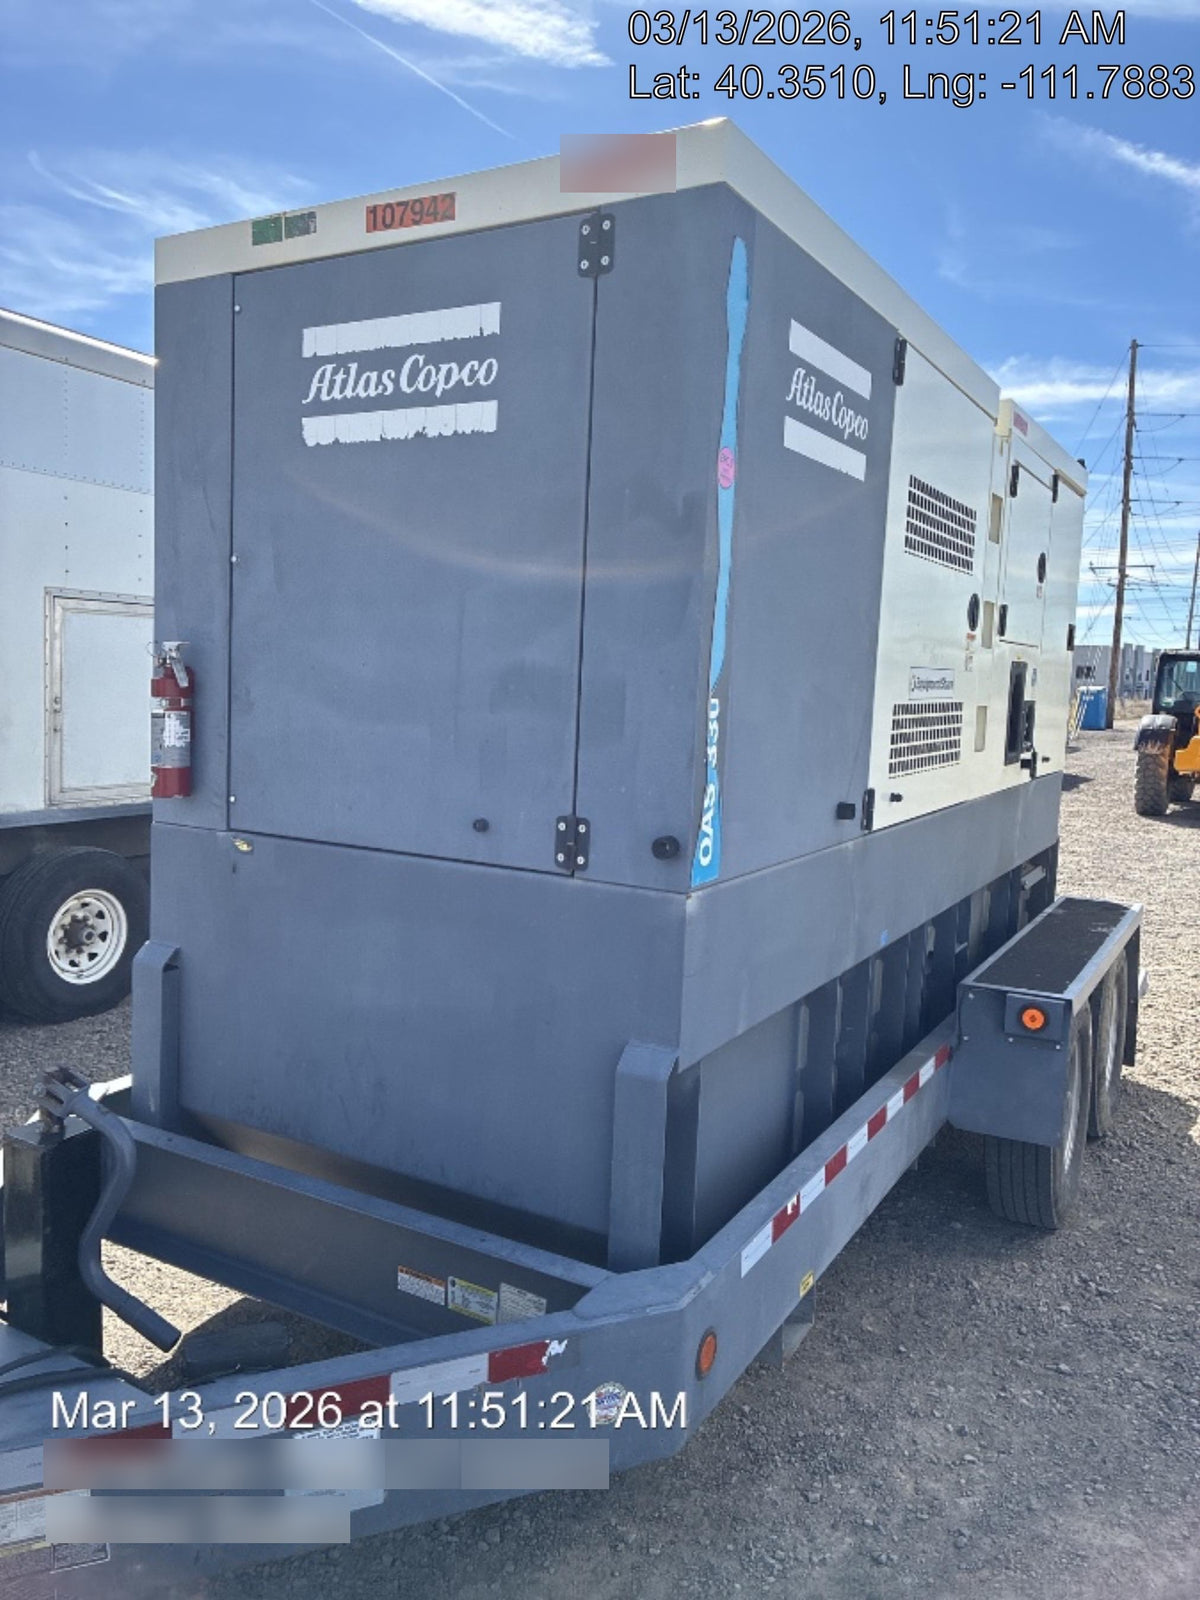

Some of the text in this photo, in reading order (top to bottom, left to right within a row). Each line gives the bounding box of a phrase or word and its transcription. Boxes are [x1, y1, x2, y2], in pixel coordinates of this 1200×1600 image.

[369, 195, 454, 231] 107942
[302, 354, 499, 404] Atlas Copco
[786, 367, 868, 440] Atlas Copco
